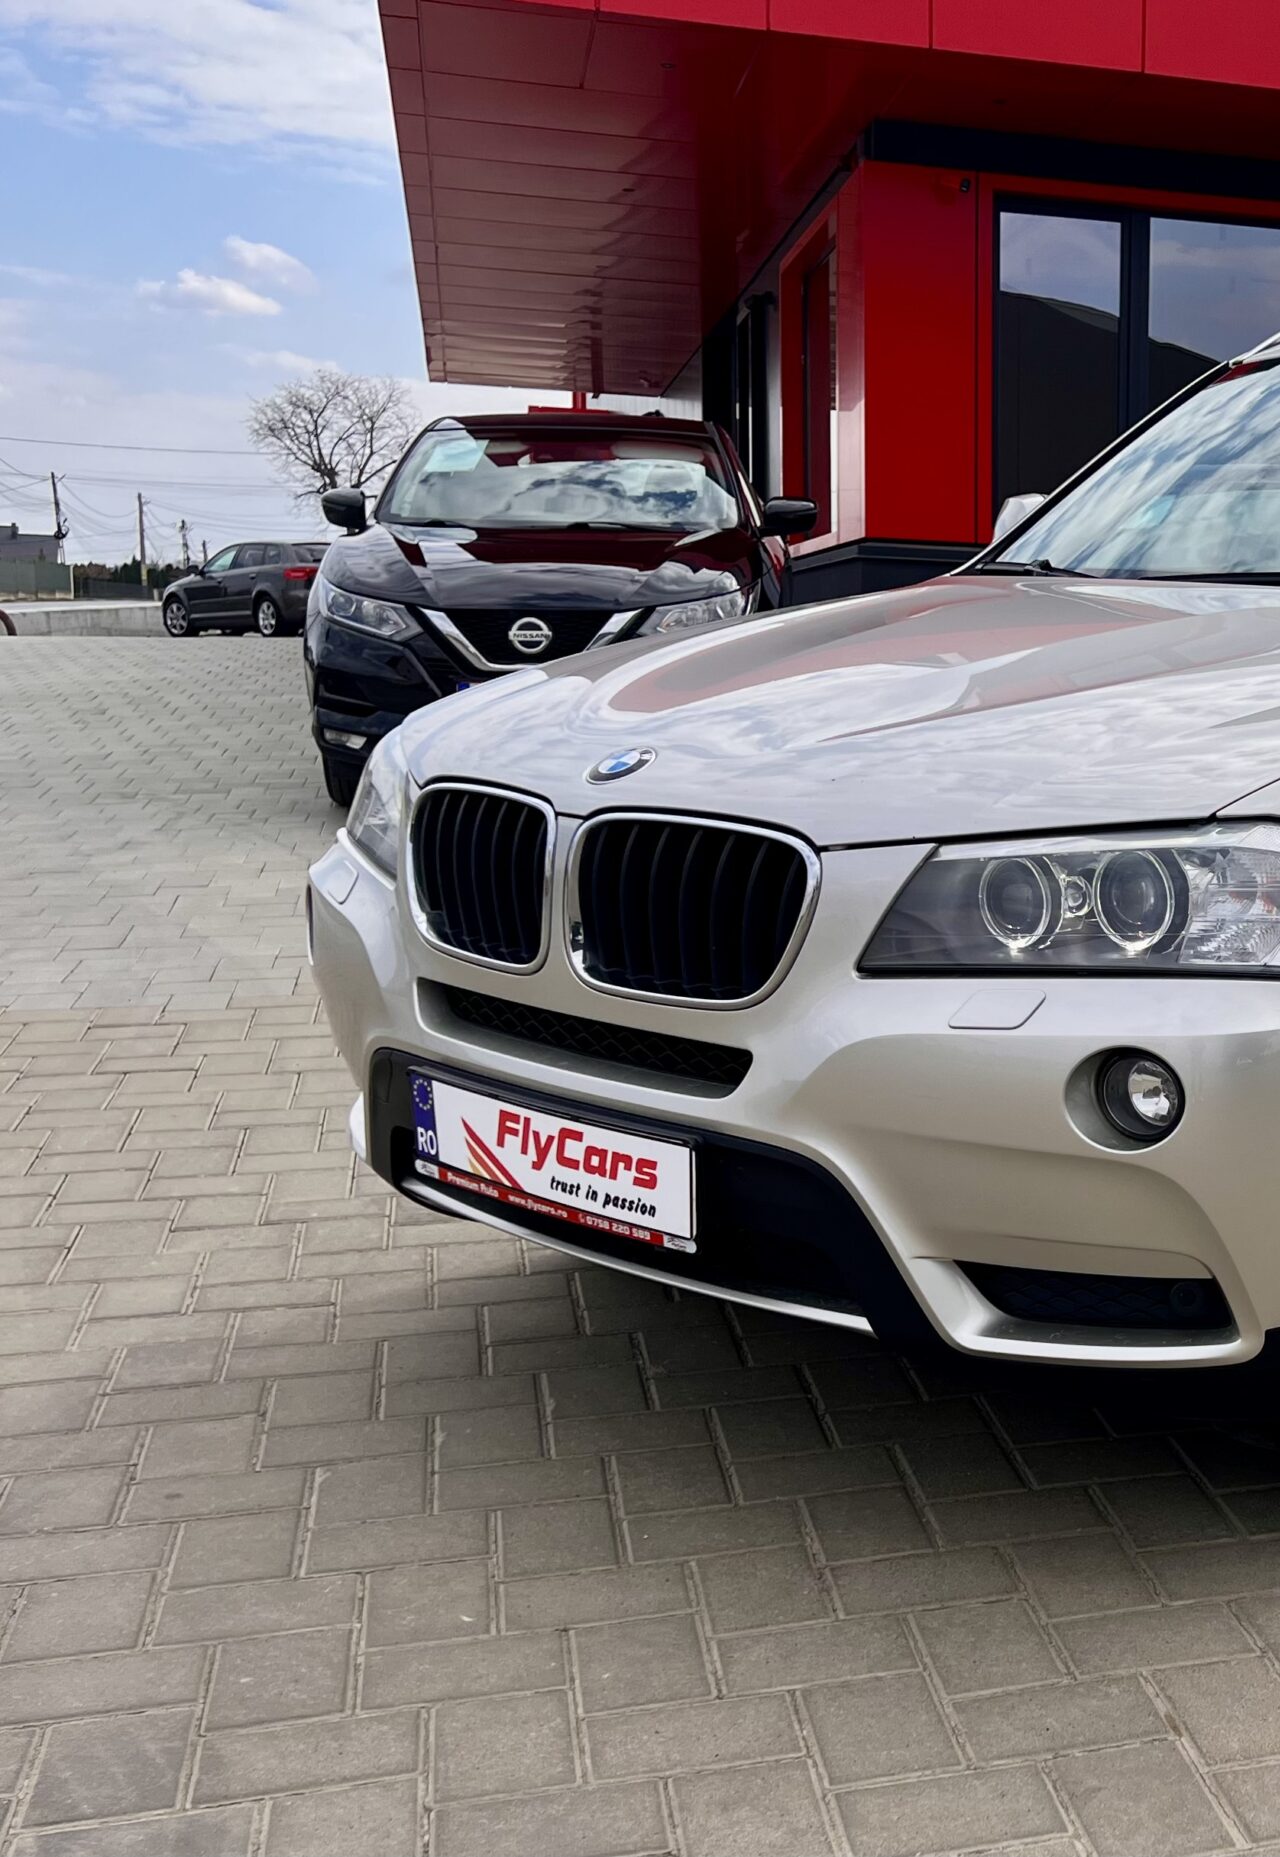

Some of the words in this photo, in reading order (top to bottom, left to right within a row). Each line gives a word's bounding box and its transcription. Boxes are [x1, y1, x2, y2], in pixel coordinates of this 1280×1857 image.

[416, 1126, 438, 1156] RO
[497, 1109, 659, 1191] FlyCars
[550, 1175, 581, 1197] trust
[586, 1184, 598, 1202] in
[602, 1191, 657, 1218] passion
